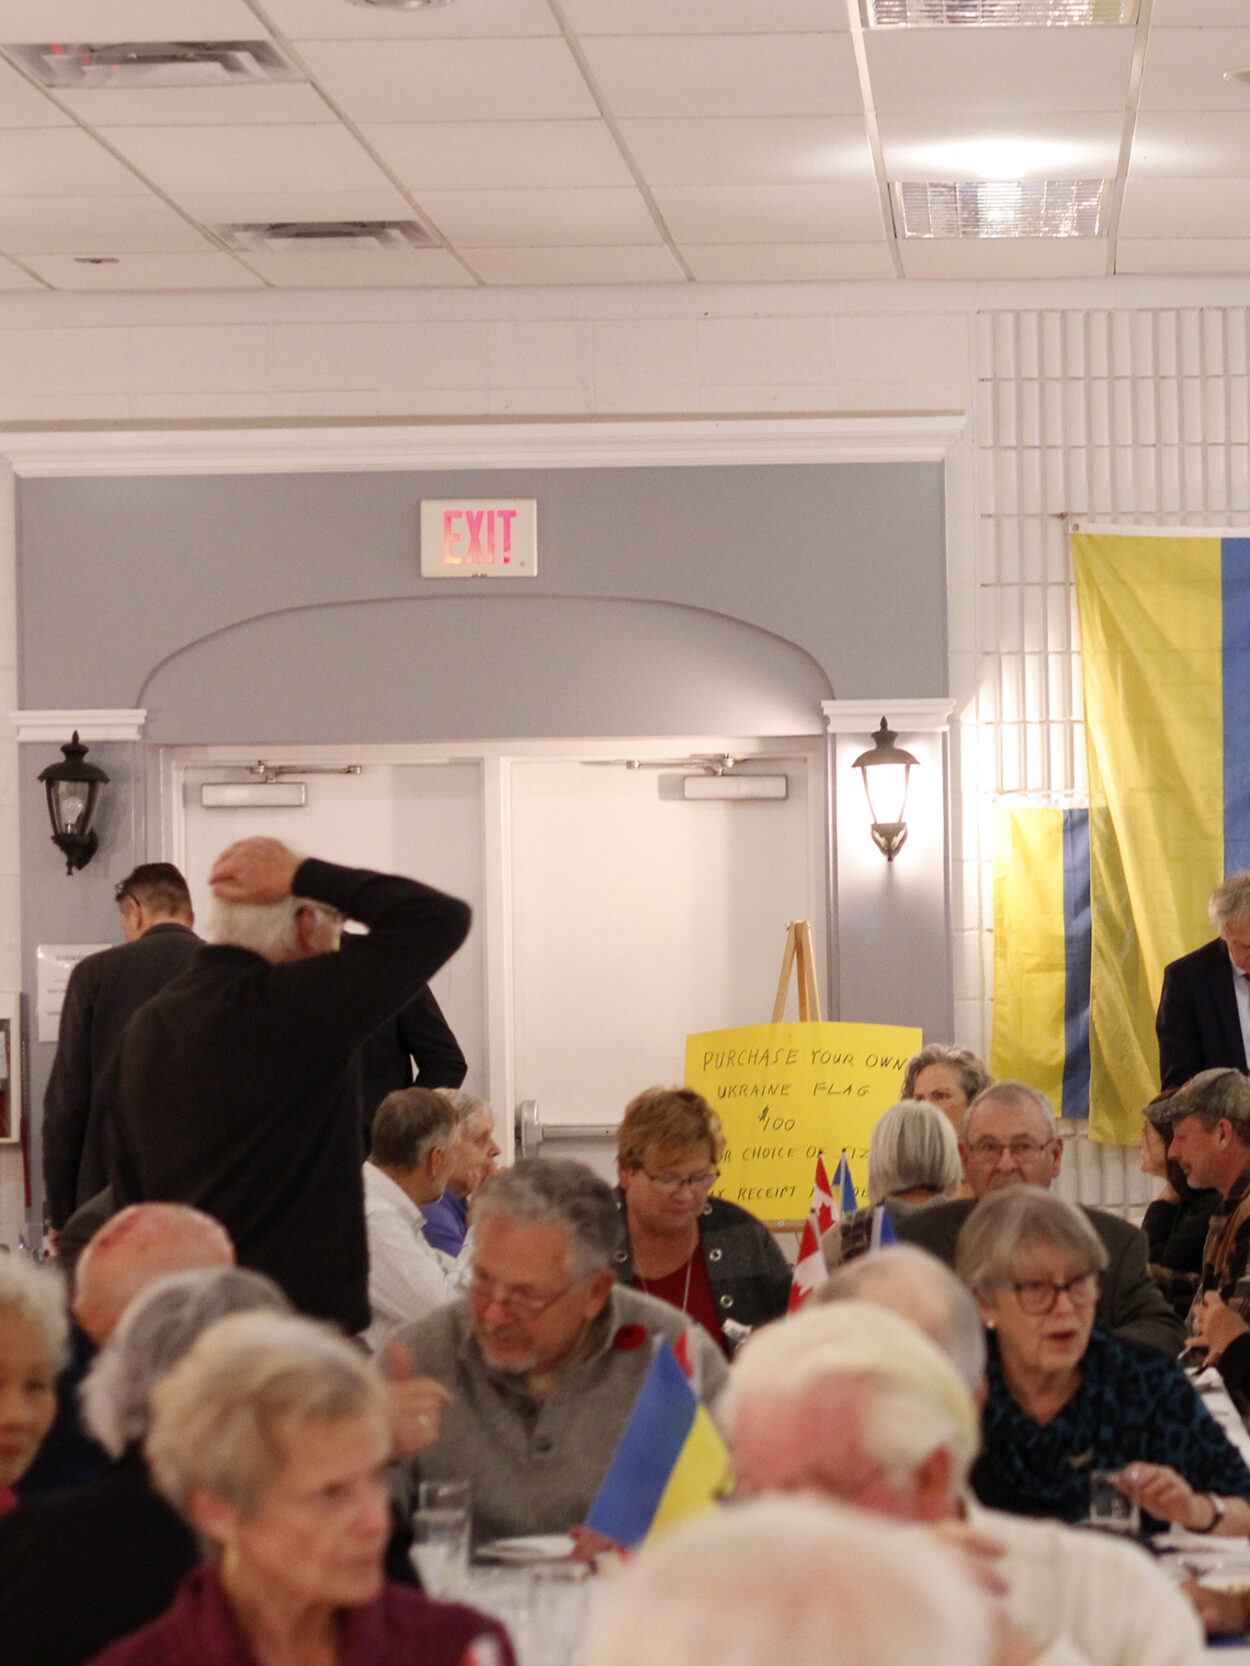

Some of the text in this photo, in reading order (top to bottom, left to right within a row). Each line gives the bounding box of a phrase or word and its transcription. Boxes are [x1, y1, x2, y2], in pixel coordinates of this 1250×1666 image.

[443, 509, 517, 565] EXIT
[703, 1048, 908, 1072] PURCHASE YOUR OWN
[717, 1081, 870, 1099] UKRAINE FLAG
[758, 1105, 796, 1132] $100
[742, 1145, 795, 1161] CHOICE
[737, 1185, 797, 1201] RECEIPT
